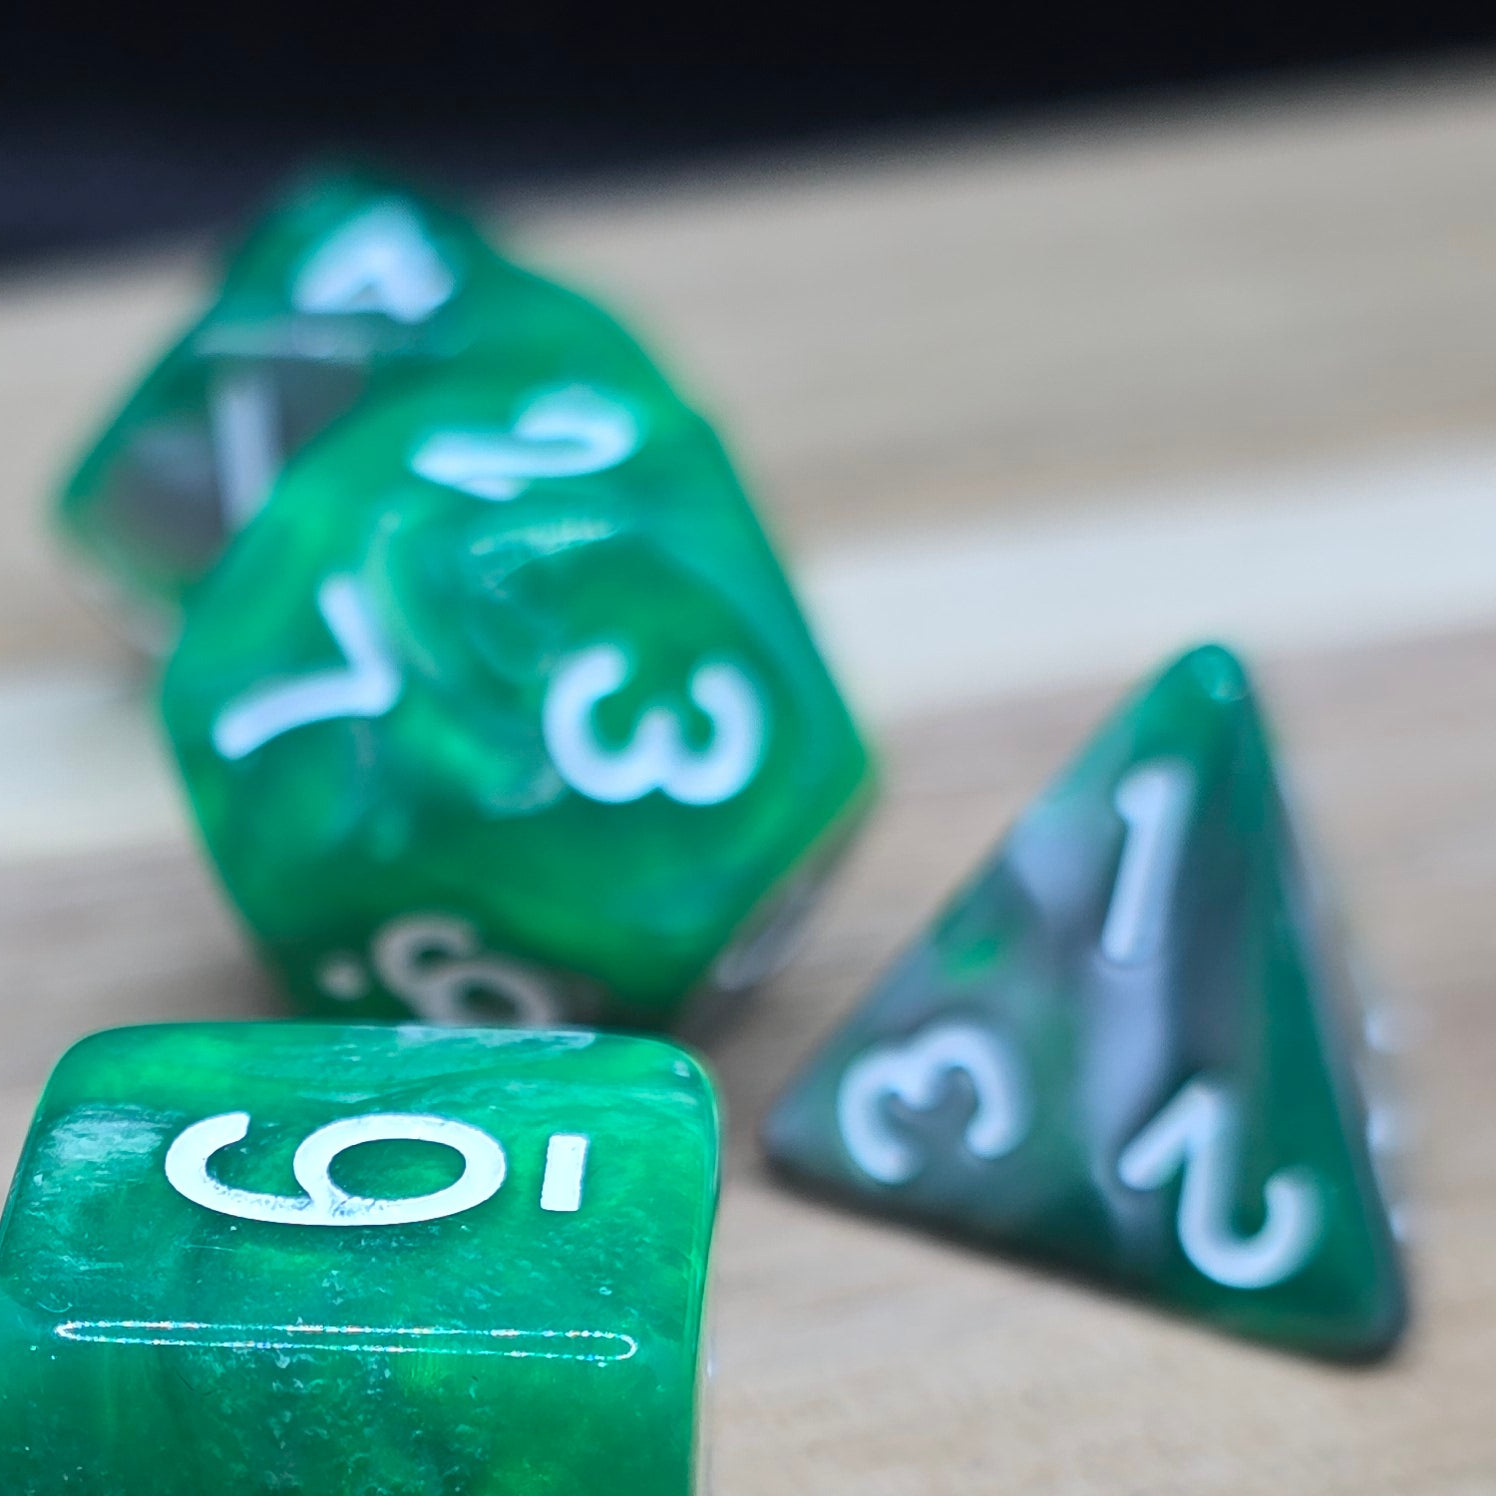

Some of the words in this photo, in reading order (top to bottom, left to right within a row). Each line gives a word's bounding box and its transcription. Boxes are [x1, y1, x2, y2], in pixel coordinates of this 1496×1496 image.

[544, 642, 762, 804] 3
[1106, 762, 1196, 965] 1
[839, 1022, 1014, 1186] 3
[1118, 1082, 1316, 1290] 2
